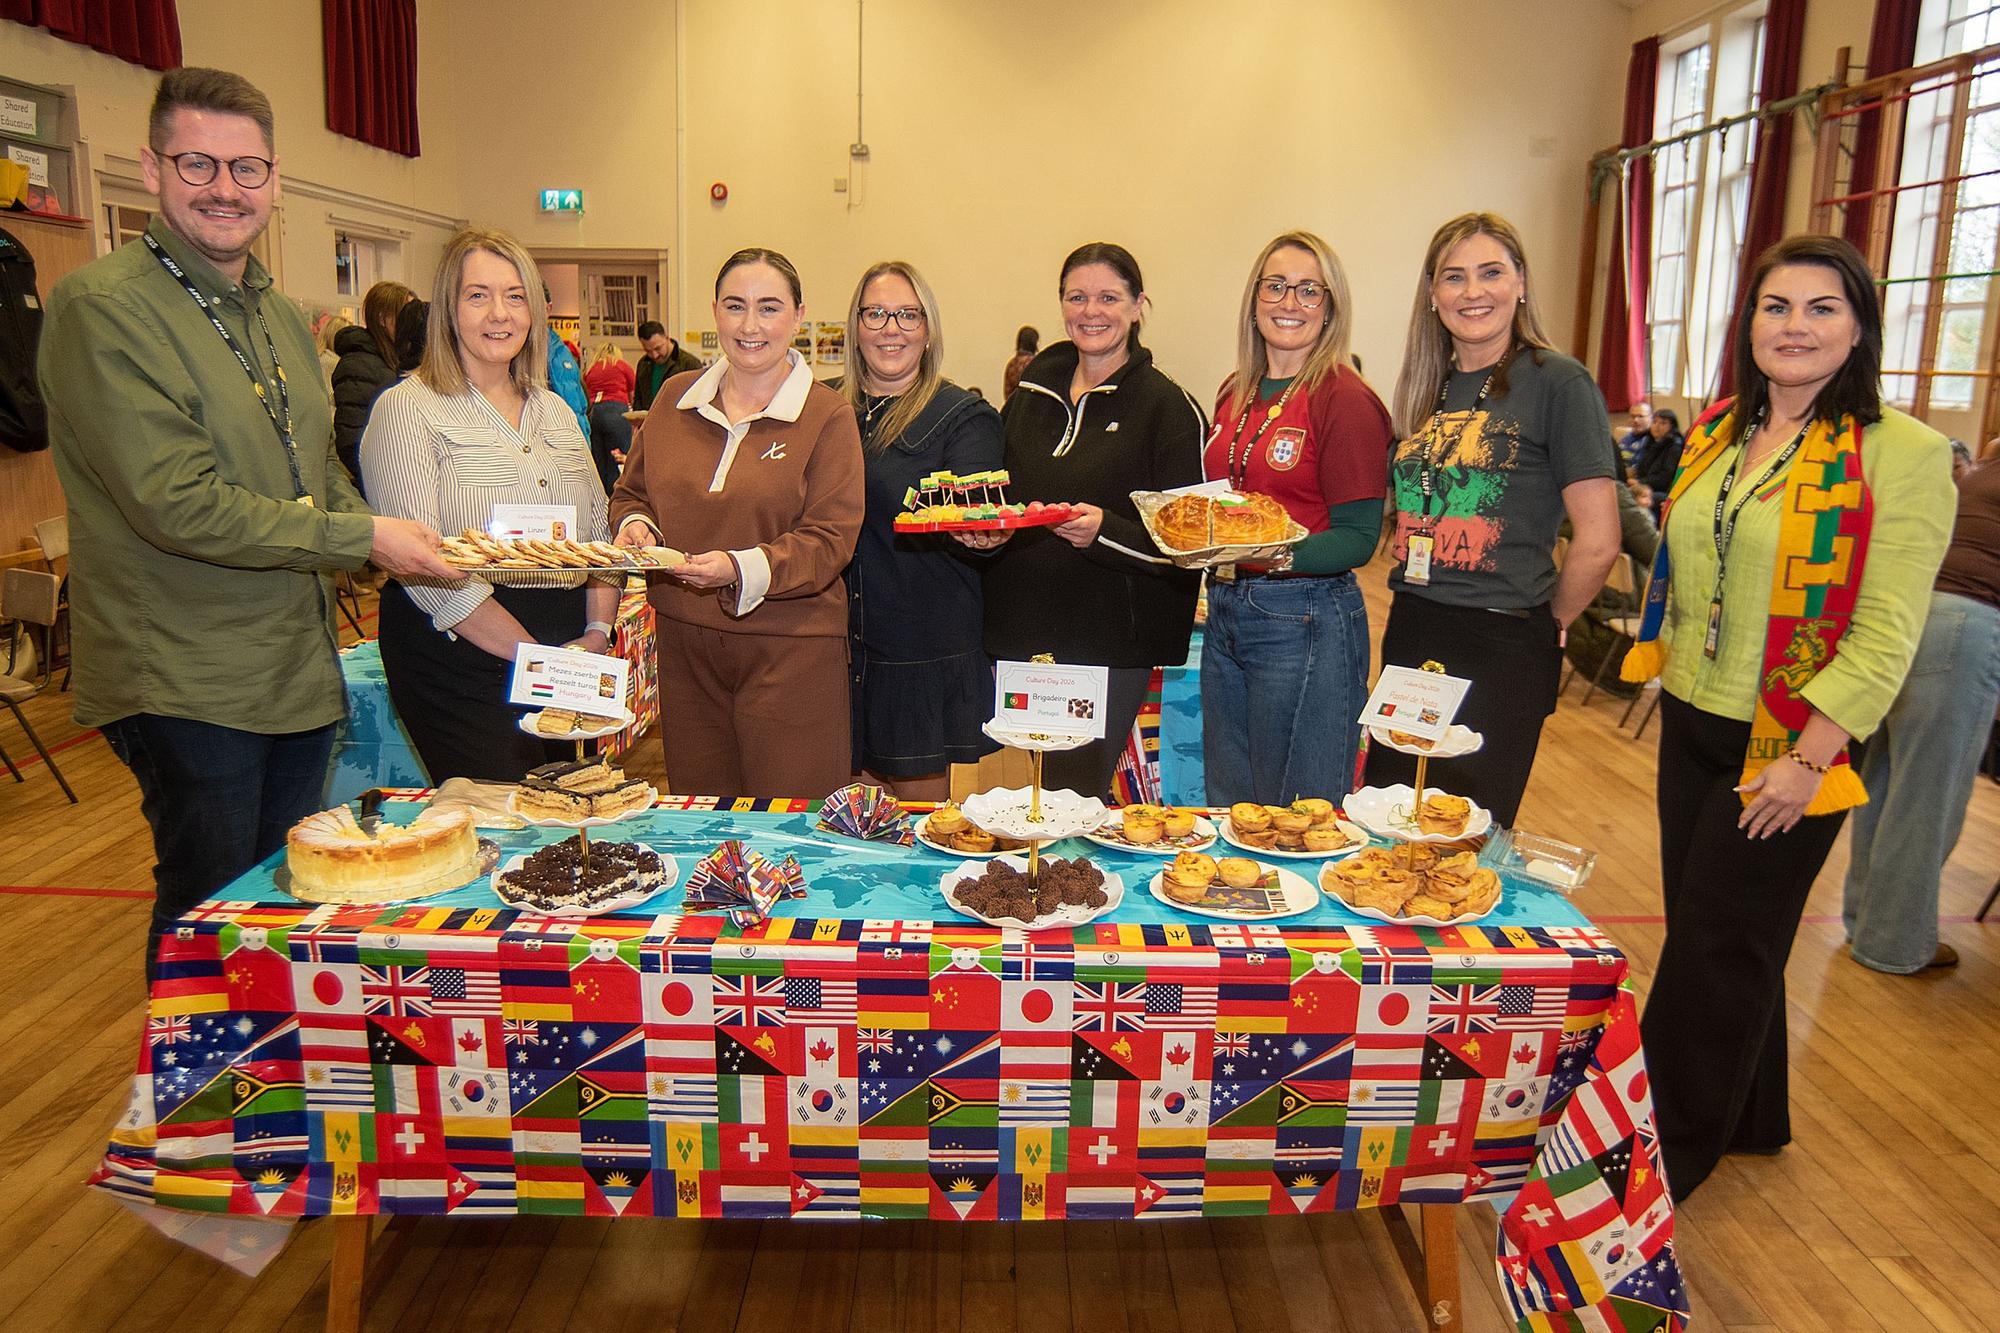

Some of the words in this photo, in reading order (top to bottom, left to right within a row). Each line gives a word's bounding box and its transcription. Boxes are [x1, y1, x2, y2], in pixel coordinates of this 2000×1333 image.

[5, 99, 29, 114] Shared
[1, 115, 34, 130] Education
[16, 151, 40, 165] Shared
[162, 257, 184, 278] STAFF
[187, 287, 208, 308] STAFF
[212, 318, 230, 340] STAFF
[1422, 443, 1432, 460] TAFF
[1780, 444, 1797, 462] STAFF
[1421, 470, 1432, 496] STAFF
[527, 526, 547, 534] Linzer
[548, 665, 572, 676] Mezes
[574, 671, 599, 680] zserbo
[549, 676, 577, 687] Reszelt
[1025, 675, 1046, 684] Culture
[1046, 677, 1059, 686] Day
[558, 688, 592, 701] Hungary
[1032, 692, 1067, 703] Brigadeiro
